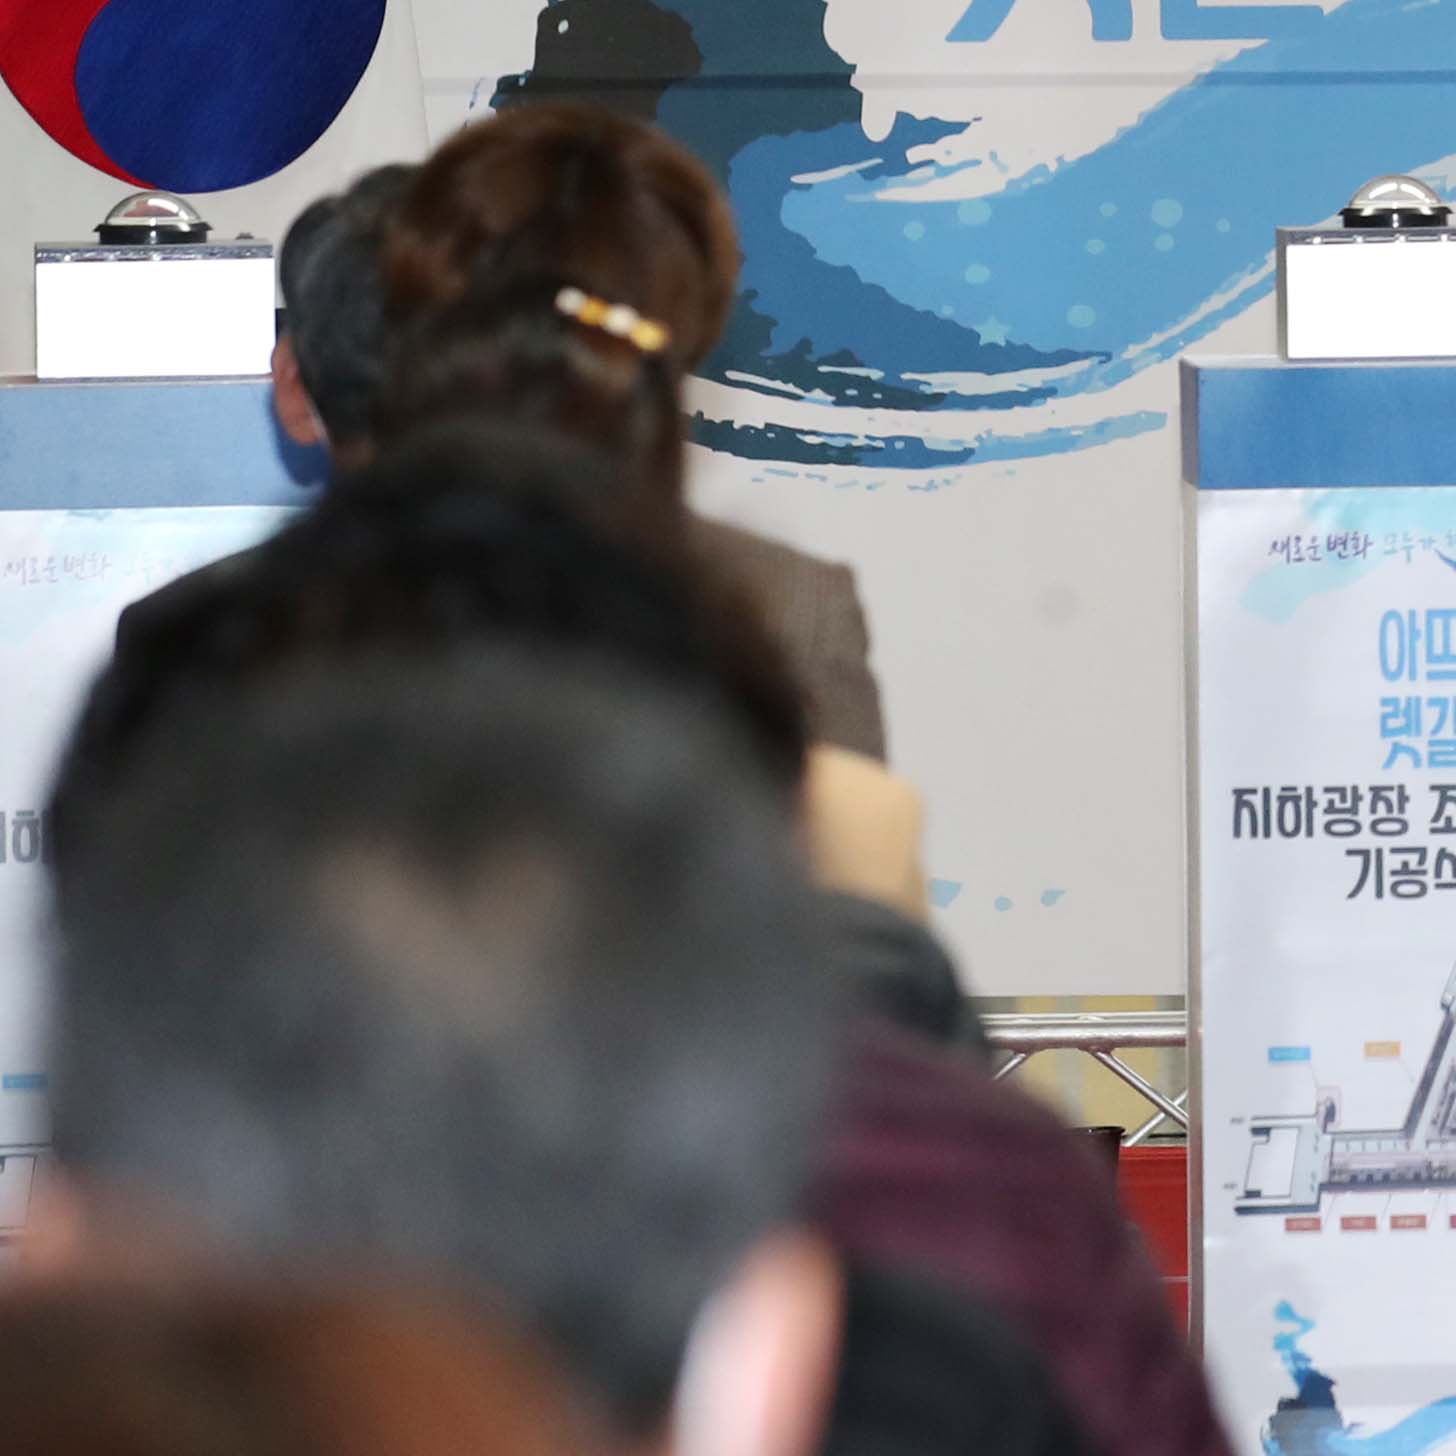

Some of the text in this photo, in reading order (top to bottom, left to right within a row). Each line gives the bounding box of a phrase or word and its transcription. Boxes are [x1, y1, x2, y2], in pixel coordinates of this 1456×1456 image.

[1268, 534, 1320, 564] 새로운
[1326, 530, 1373, 561] 변화
[1232, 783, 1410, 840] 지하광장
